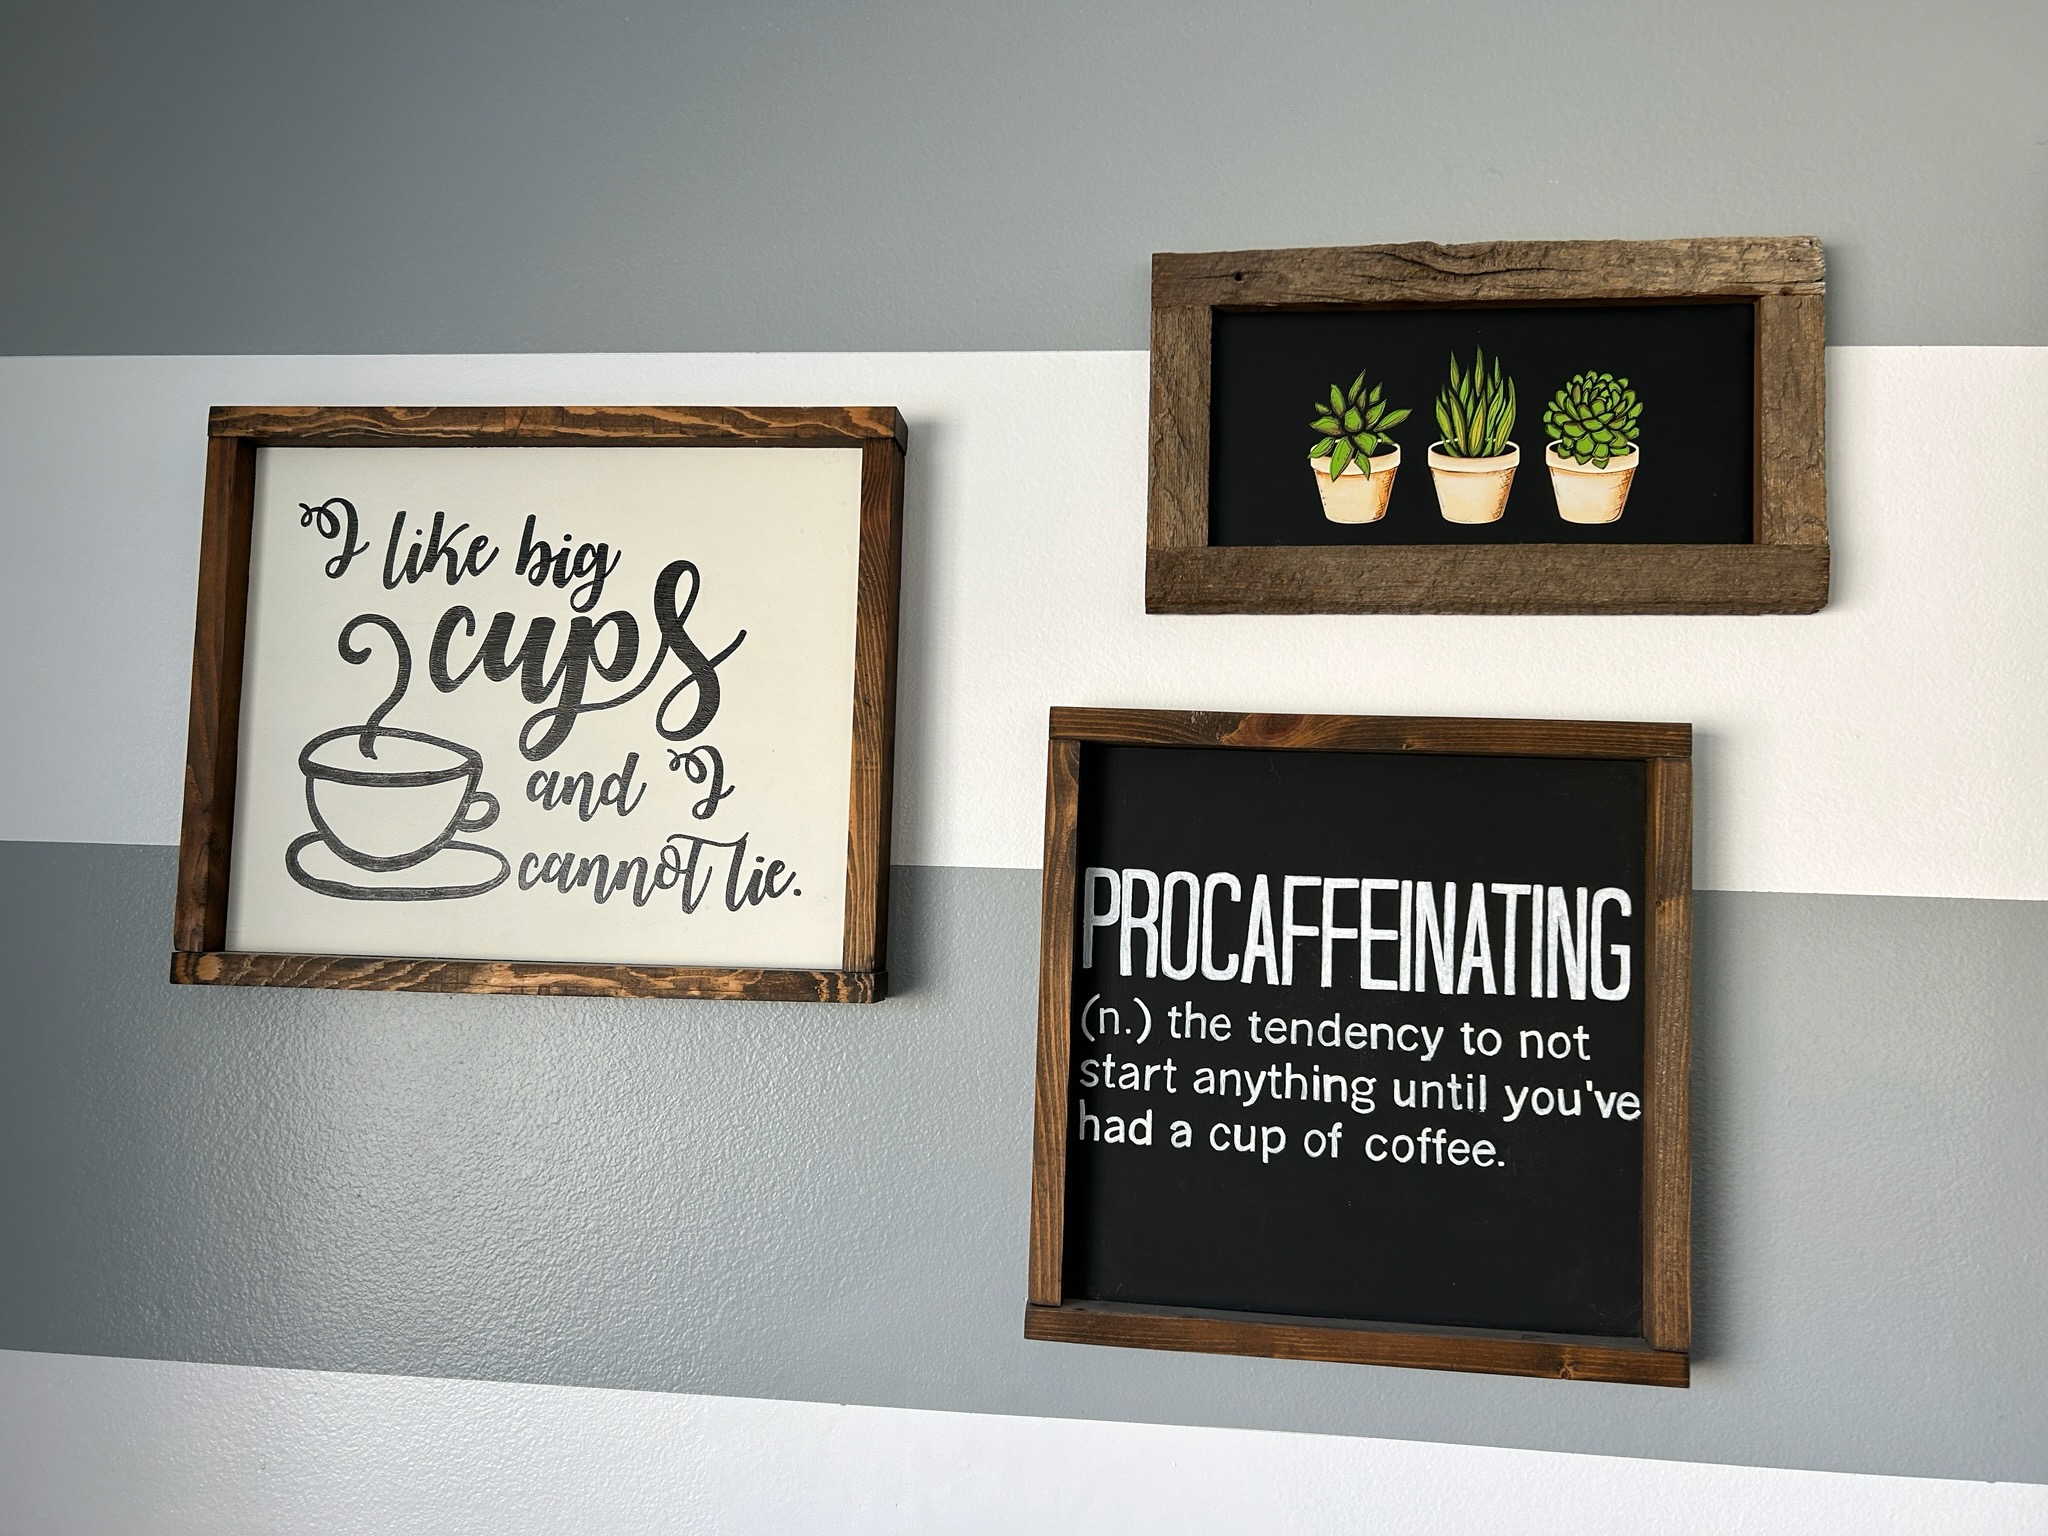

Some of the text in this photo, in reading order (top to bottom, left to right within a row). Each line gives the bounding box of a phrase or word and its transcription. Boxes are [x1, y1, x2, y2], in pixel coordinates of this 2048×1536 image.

[299, 497, 621, 613] I like big
[429, 559, 747, 761] cups
[526, 745, 735, 822] and I
[518, 833, 803, 914] cannot lie.
[1082, 867, 1632, 1001] PROCAFFEINATING
[1081, 994, 1592, 1061] (n.) the tendency to not
[1080, 1053, 1642, 1122] start anything until you've
[1080, 1100, 1506, 1168] had a cup of coffee.
